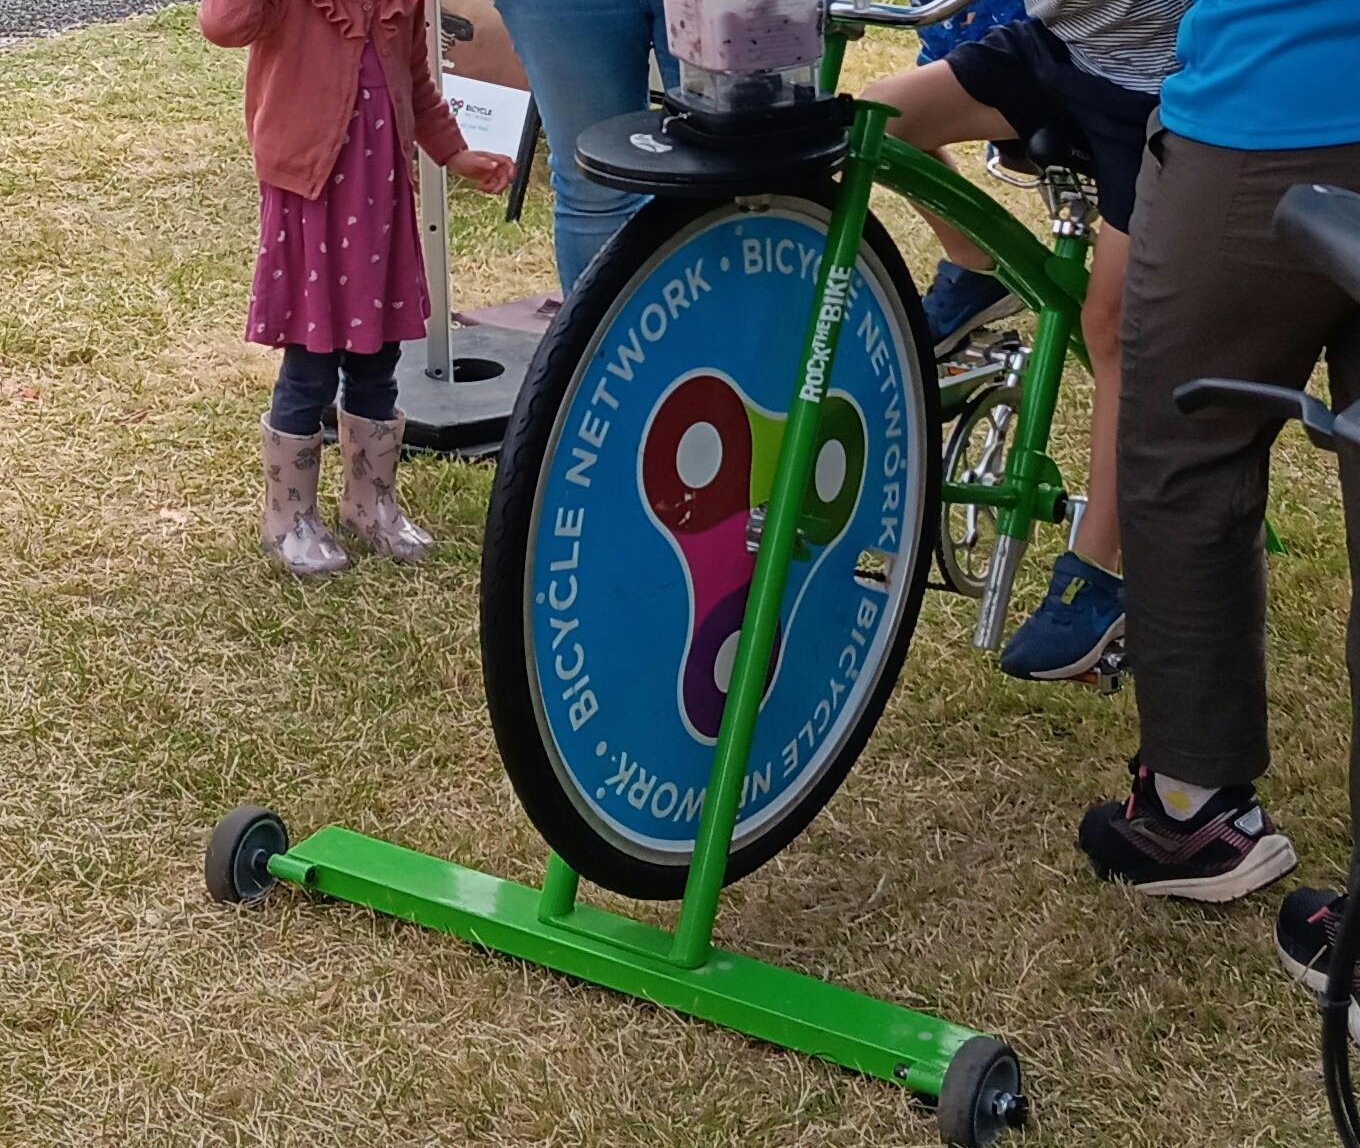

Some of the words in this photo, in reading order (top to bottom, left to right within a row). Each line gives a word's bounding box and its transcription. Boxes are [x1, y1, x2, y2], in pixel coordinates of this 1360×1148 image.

[564, 257, 713, 488] NETWORK
[799, 348, 832, 404] ROCK
[820, 264, 852, 323] BIKE
[856, 310, 904, 547] NETWORK
[549, 507, 599, 732] BICYCLE
[781, 595, 879, 778] BICYCLE
